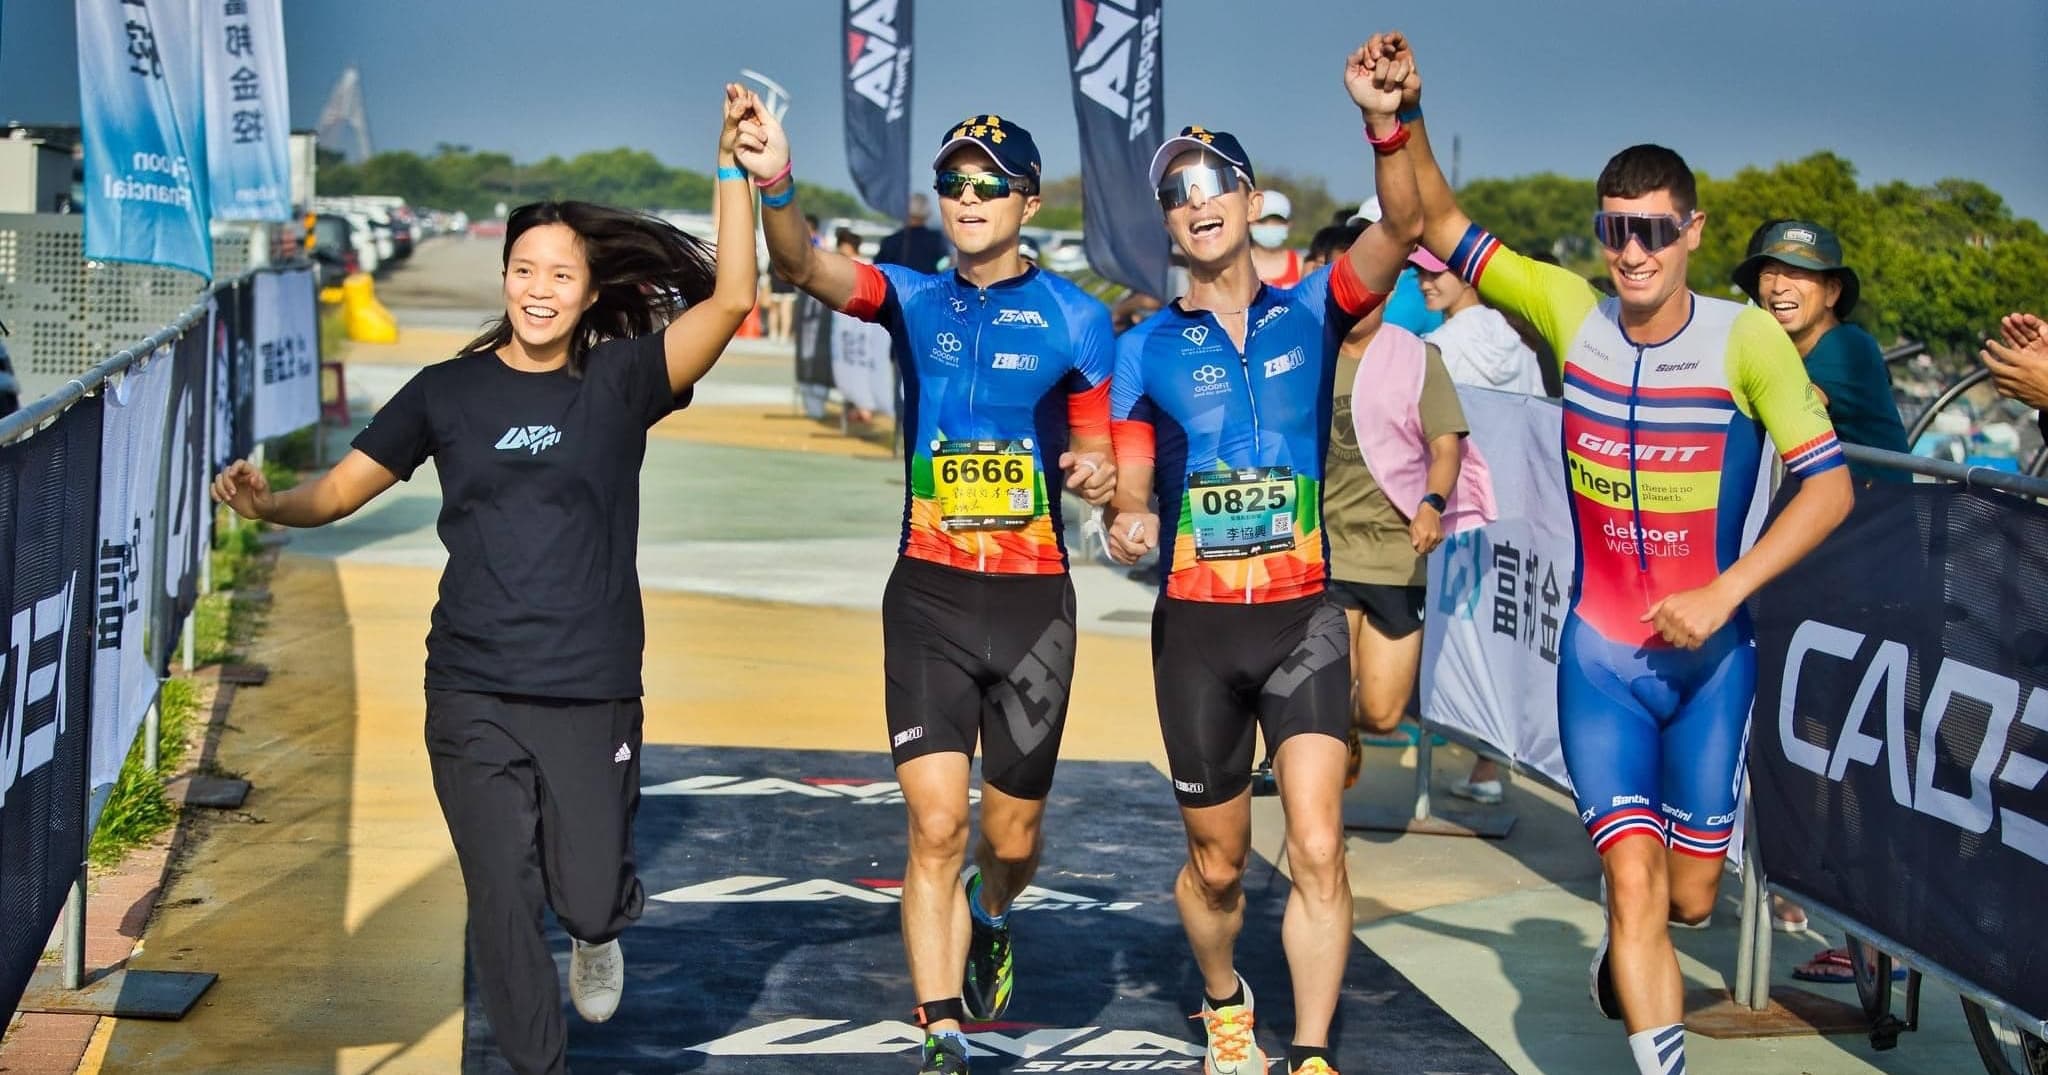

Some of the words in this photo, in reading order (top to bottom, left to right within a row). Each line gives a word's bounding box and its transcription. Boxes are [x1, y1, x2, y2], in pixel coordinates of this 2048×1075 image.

[1655, 360, 1700, 372] Santini
[529, 431, 562, 455] TRI
[1577, 432, 1711, 463] GIANT
[942, 459, 1024, 484] 6666
[1580, 464, 1632, 502] hep
[1202, 485, 1287, 515] 0825
[1641, 484, 1668, 493] there
[1642, 493, 1673, 501] planet
[1603, 517, 1688, 542] deboer
[1605, 537, 1690, 557] wetsuits
[1493, 540, 1575, 665] 富邦金
[1612, 793, 1650, 807] Santini
